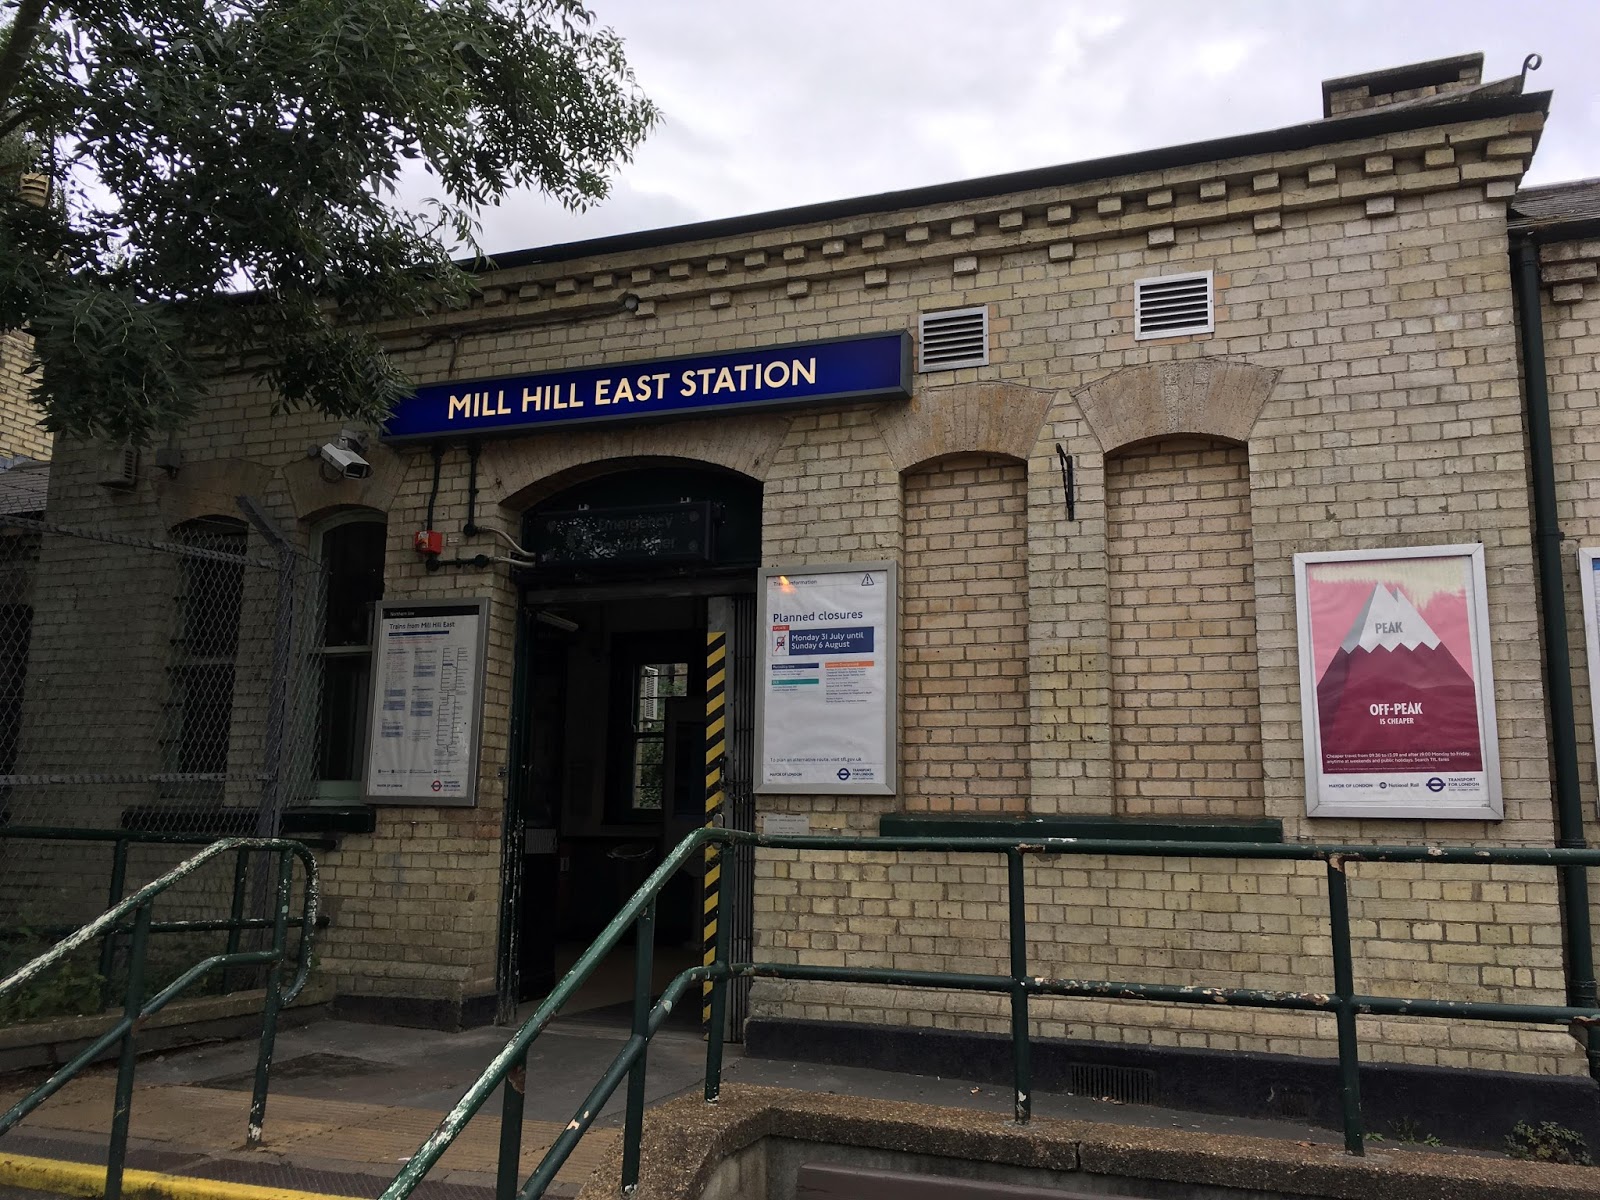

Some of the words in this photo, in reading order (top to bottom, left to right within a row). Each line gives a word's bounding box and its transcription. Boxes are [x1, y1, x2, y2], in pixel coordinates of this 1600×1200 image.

[448, 390, 512, 420] MILL
[521, 383, 584, 412] HILL
[594, 373, 671, 405] EAST
[680, 358, 817, 396] STATION
[773, 612, 815, 623] Planned
[818, 610, 864, 621] closures
[1375, 622, 1403, 634] PEAK
[791, 634, 820, 643] Monday
[829, 633, 846, 641] July
[791, 642, 818, 650] Sunday
[826, 641, 851, 649] August
[1370, 702, 1423, 716] OFF-PEAK
[1387, 717, 1415, 725] CHEAPER
